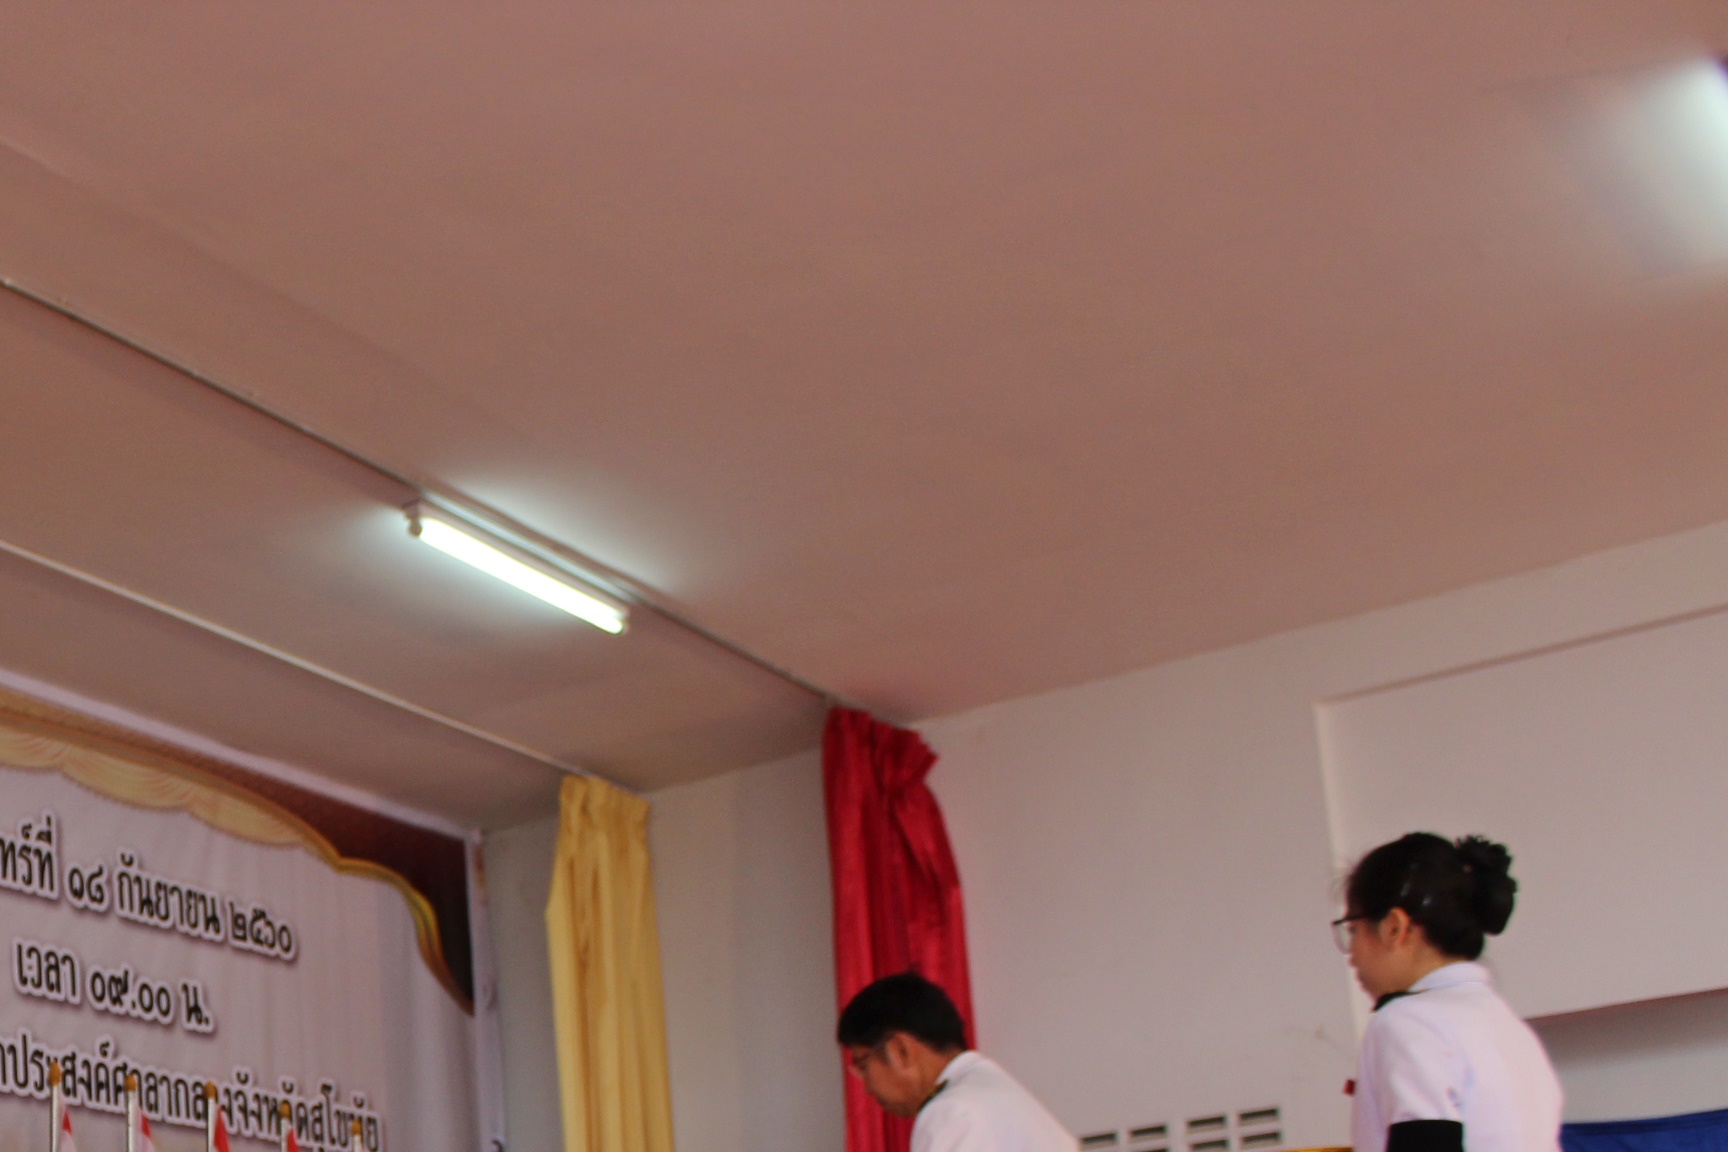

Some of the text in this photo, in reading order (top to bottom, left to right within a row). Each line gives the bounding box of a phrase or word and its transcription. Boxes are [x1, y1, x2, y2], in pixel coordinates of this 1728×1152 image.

[68, 865, 105, 905] ๑๘
[117, 853, 222, 935] กันยายน
[228, 900, 293, 953] ๒๕๖๐
[16, 943, 210, 1026] เวลา ๐๙.๐๐ น.
